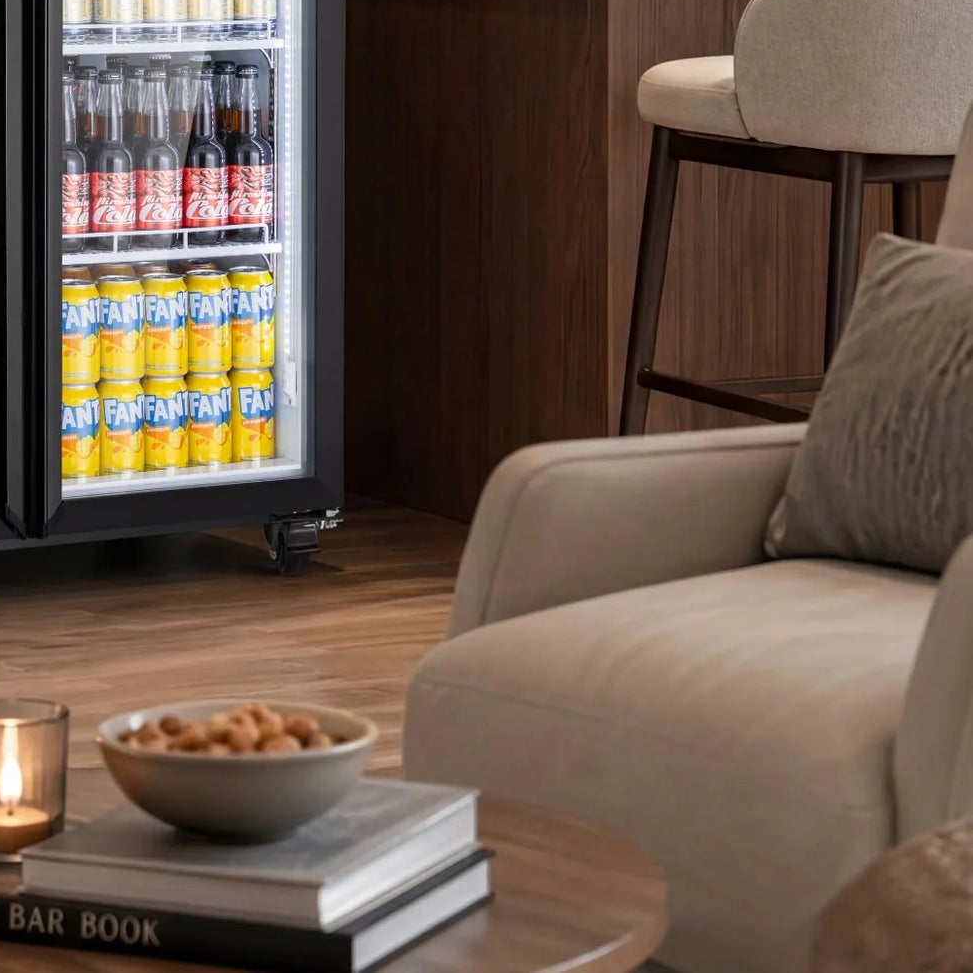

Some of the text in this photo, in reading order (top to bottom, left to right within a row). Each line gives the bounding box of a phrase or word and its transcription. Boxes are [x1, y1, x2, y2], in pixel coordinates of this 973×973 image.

[232, 285, 273, 314] FANT
[9, 903, 65, 936] BAR
[80, 911, 161, 947] BOOK
